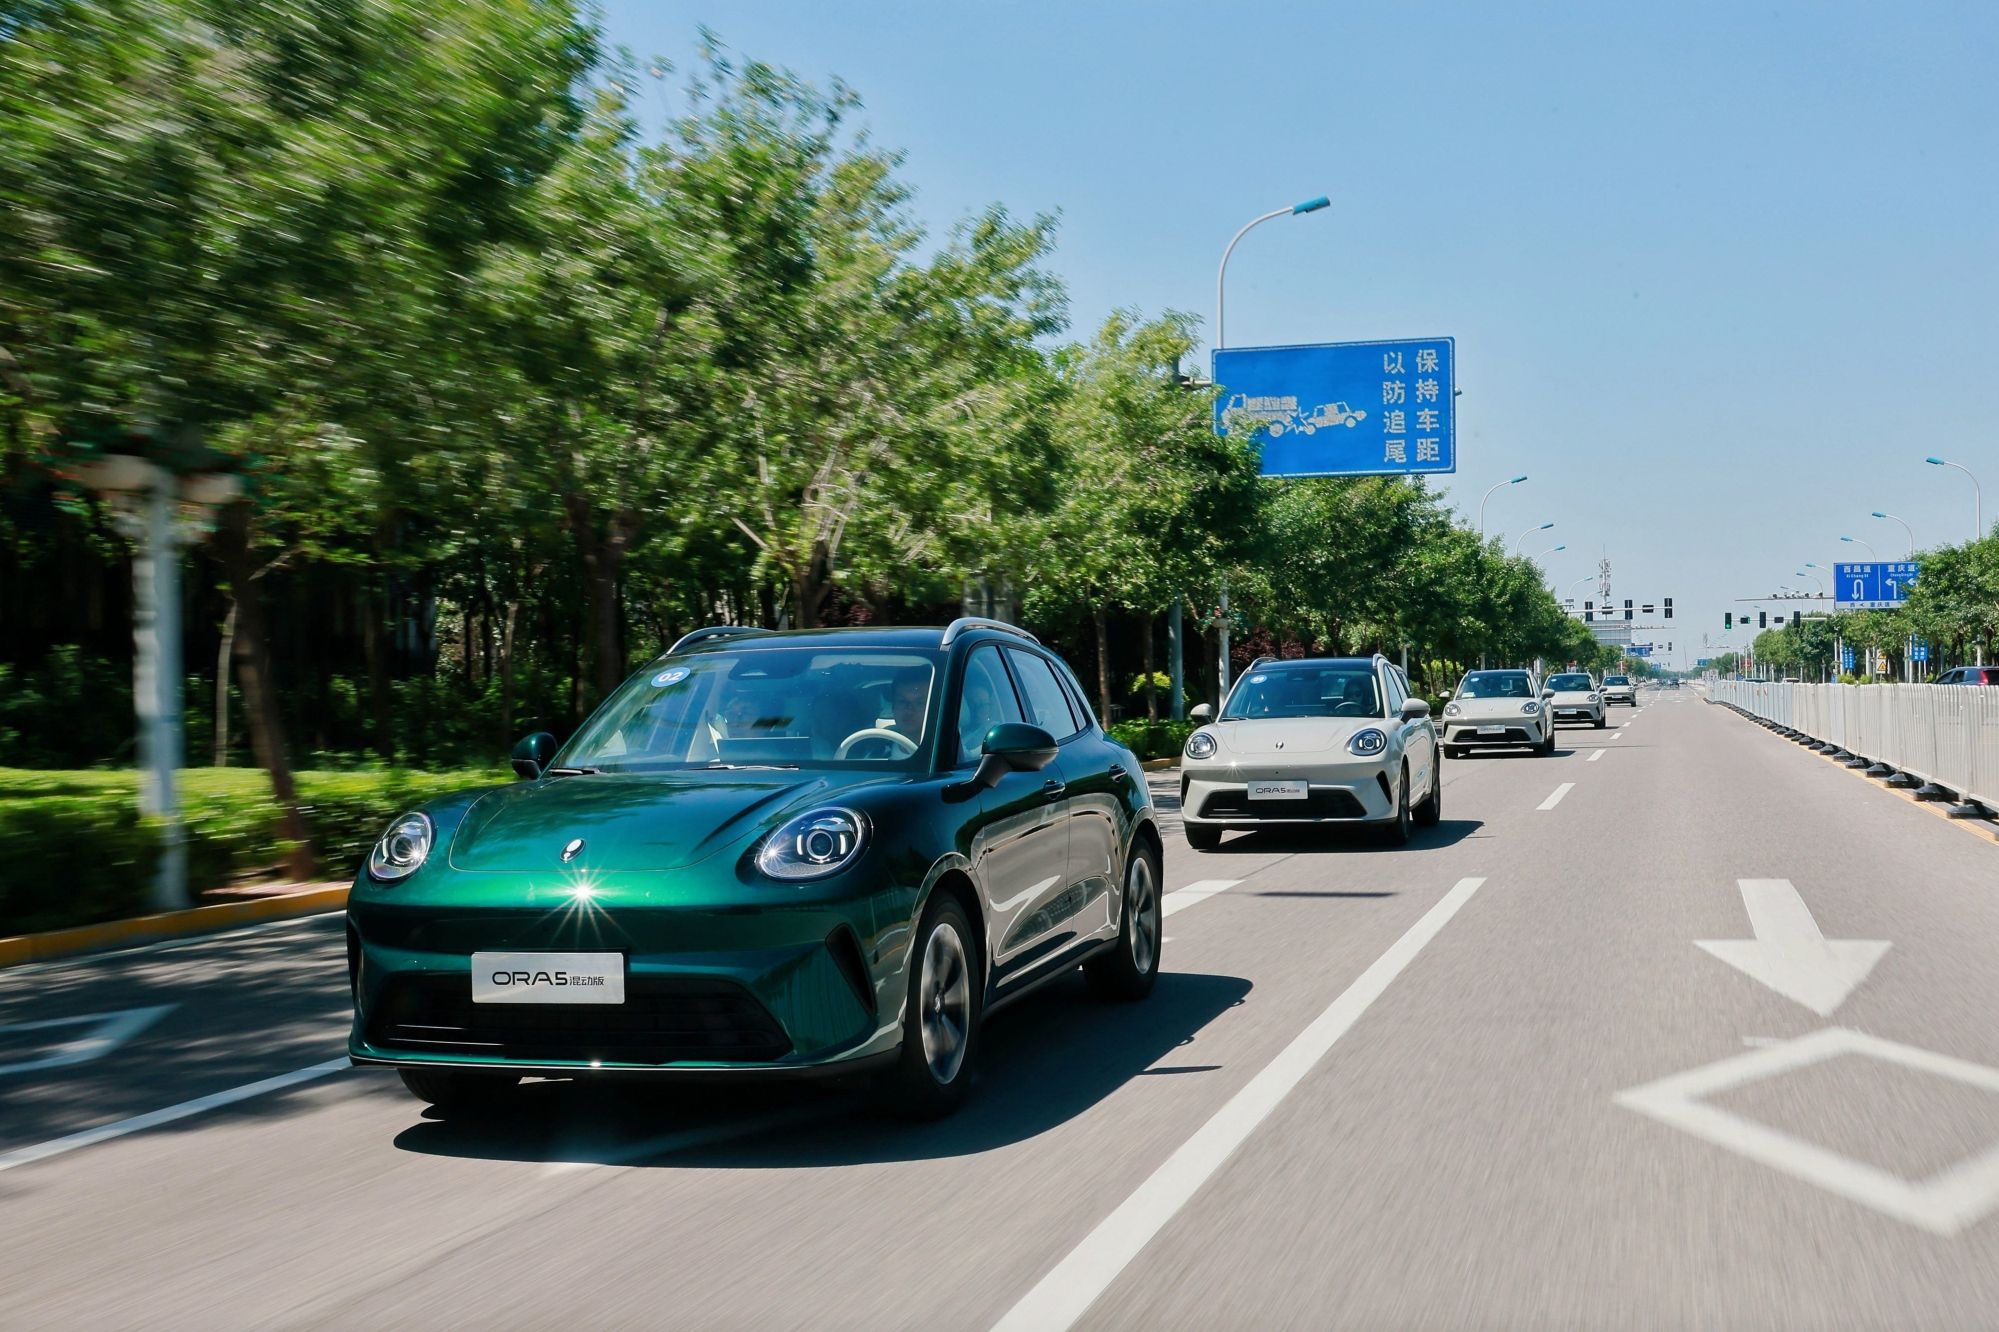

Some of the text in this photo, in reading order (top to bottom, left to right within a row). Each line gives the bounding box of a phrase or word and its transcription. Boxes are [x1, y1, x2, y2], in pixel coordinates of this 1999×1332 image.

[1383, 351, 1407, 463] 以防追尾
[1415, 349, 1440, 462] 保持车距
[658, 672, 684, 682] 02
[492, 971, 605, 986] ORA5 混动版
